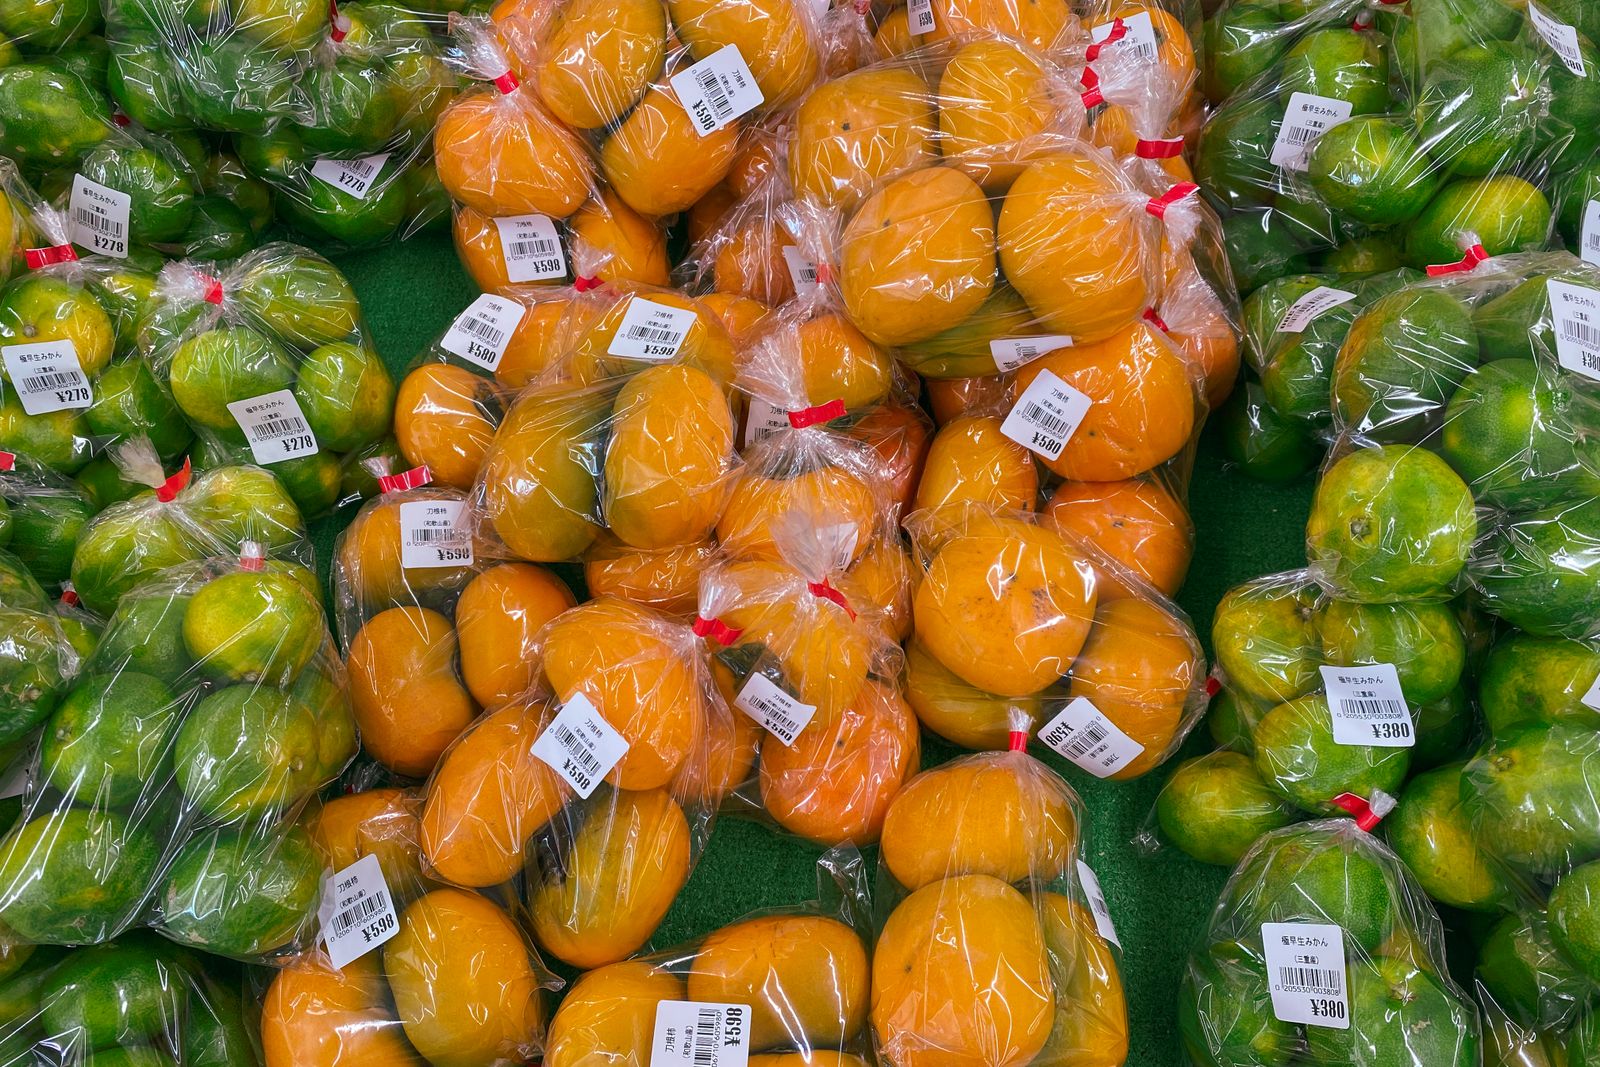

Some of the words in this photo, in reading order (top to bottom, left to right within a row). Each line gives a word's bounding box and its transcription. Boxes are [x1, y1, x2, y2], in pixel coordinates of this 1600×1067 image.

[731, 69, 746, 88] 刀根柿
[692, 99, 716, 130] ¥598
[338, 171, 365, 192] ¥278
[94, 234, 124, 252] ¥278
[533, 258, 560, 273] ¥598
[19, 351, 62, 363] 極早生みかん
[467, 341, 496, 364] ¥580
[643, 344, 675, 355] ¥598
[1582, 350, 1600, 372] ¥380
[55, 387, 89, 402] ¥278
[1050, 387, 1069, 403] 刀根柿
[245, 400, 284, 414] 極早生みかん
[281, 434, 313, 452] ¥278
[1031, 431, 1062, 454] ¥580
[1337, 676, 1383, 684] 極早生みかん
[584, 718, 603, 738] 刀根柿
[764, 718, 792, 741] ¥580
[1046, 722, 1074, 746] ¥598
[1371, 722, 1410, 738] ¥380
[562, 757, 590, 790] ¥598
[337, 875, 358, 893] 刀根柿
[337, 920, 361, 939] 206710
[362, 906, 385, 924] 605980
[361, 913, 394, 943] ¥598
[1281, 935, 1328, 947] 極早生みかん
[1283, 984, 1310, 993] 205530
[1312, 987, 1339, 996] 003808
[1309, 998, 1345, 1019] ¥380
[724, 1008, 743, 1046] ¥598
[665, 1028, 676, 1052] 刀根柿
